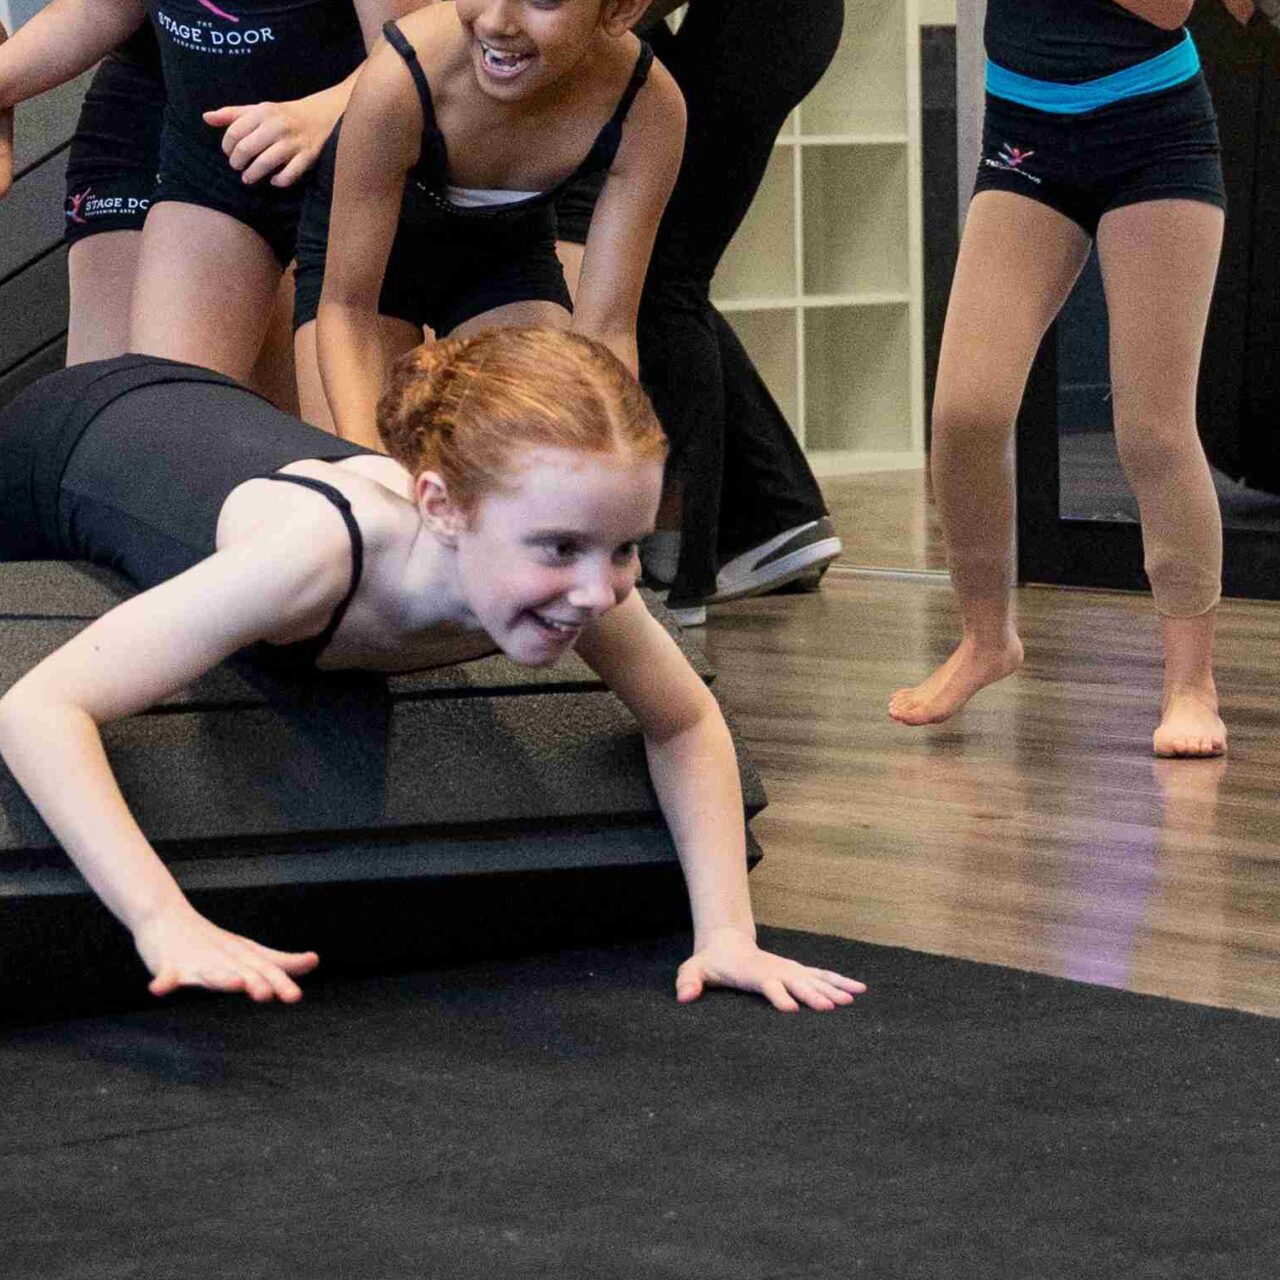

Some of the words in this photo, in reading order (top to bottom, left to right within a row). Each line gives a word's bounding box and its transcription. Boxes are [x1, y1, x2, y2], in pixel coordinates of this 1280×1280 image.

[158, 11, 202, 43] STAGE
[210, 27, 275, 45] DOOR
[85, 197, 122, 211] STAGE
